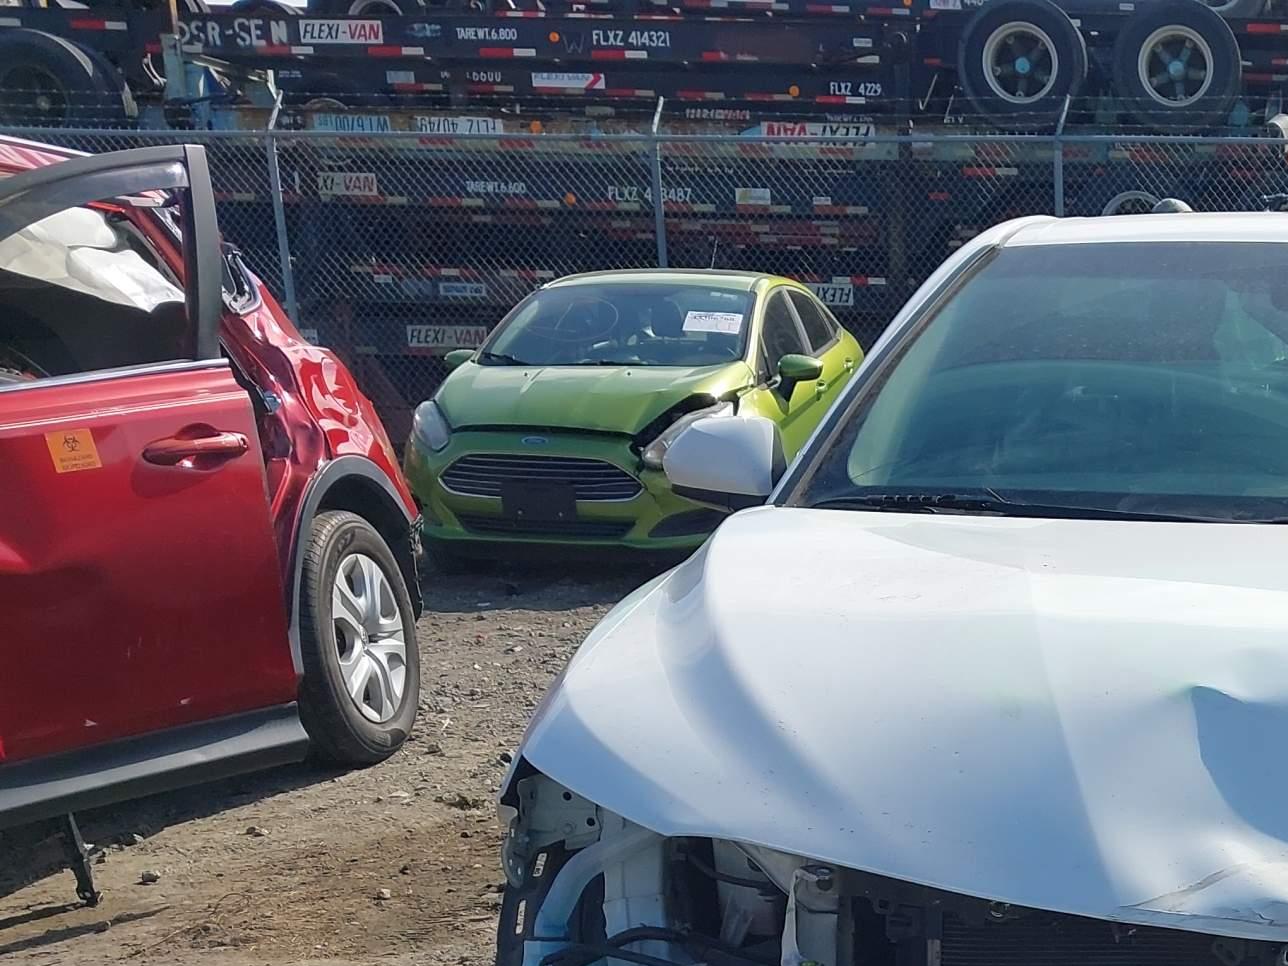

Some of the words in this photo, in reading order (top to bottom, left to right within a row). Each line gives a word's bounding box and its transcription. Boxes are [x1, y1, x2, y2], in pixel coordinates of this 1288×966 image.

[303, 23, 380, 41] FLEXI-VAN
[592, 30, 624, 46] FLXZ
[628, 31, 670, 47] 414321
[830, 81, 852, 95] FLXZ
[410, 328, 485, 344] FLEXI-VAN
